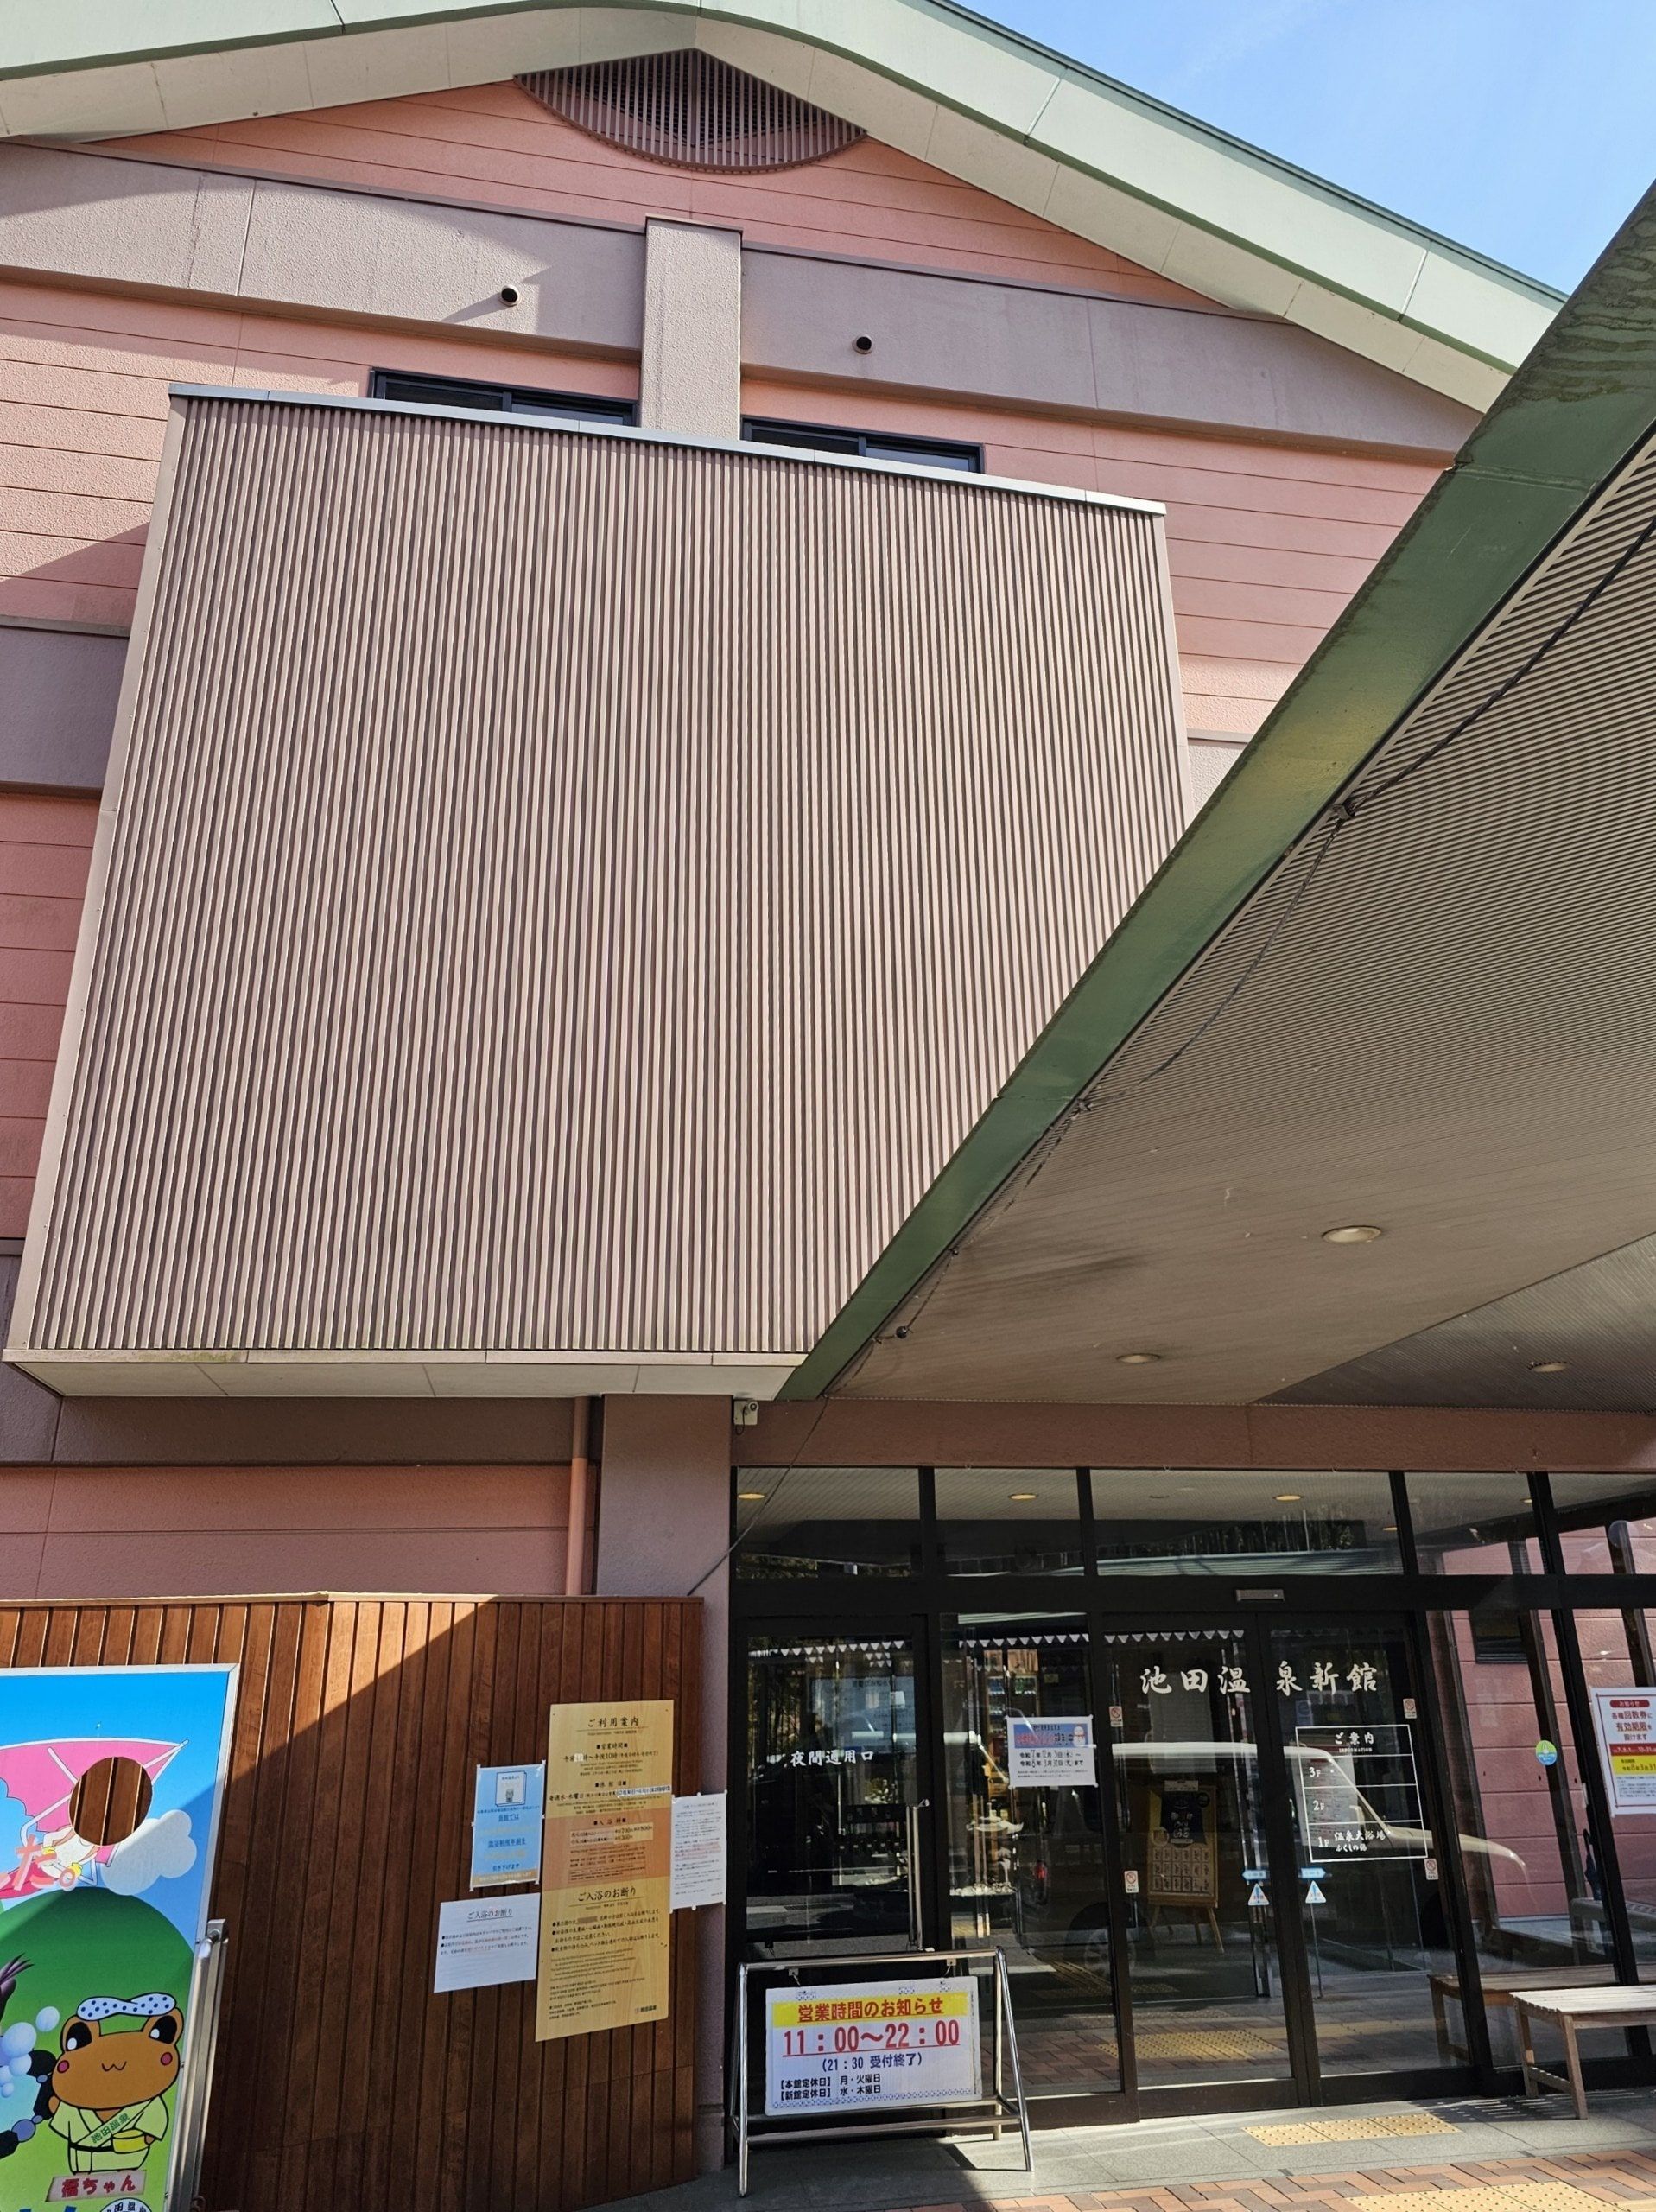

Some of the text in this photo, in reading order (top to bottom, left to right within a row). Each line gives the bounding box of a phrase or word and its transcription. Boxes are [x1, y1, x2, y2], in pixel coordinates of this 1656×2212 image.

[1140, 1660, 1378, 1696] 池田温泉新館
[588, 1716, 638, 1727] ご利用案内
[1615, 1722, 1653, 1732] 有効期限を
[1335, 1732, 1374, 1745] ご案内
[790, 1749, 873, 1767] 夜間通用口
[1309, 1767, 1321, 1778] 3F
[1313, 1800, 1325, 1811] 2F
[1317, 1836, 1329, 1847] 1F
[1334, 1830, 1386, 1842] 温泉大浴場
[0, 1834, 77, 1891] た。
[578, 1885, 637, 1901] ご入浴のお断り
[467, 1908, 513, 1920] ご入浴のお断り
[797, 1996, 943, 2023] 営業時間のお知らせ
[780, 2073, 881, 2090] 【本館定休日】 月・火曜日
[780, 2084, 881, 2101] 【新館定休日】 水・木曜日
[90, 2113, 130, 2144] 池田温泉
[61, 2175, 136, 2198] 福ちゃん
